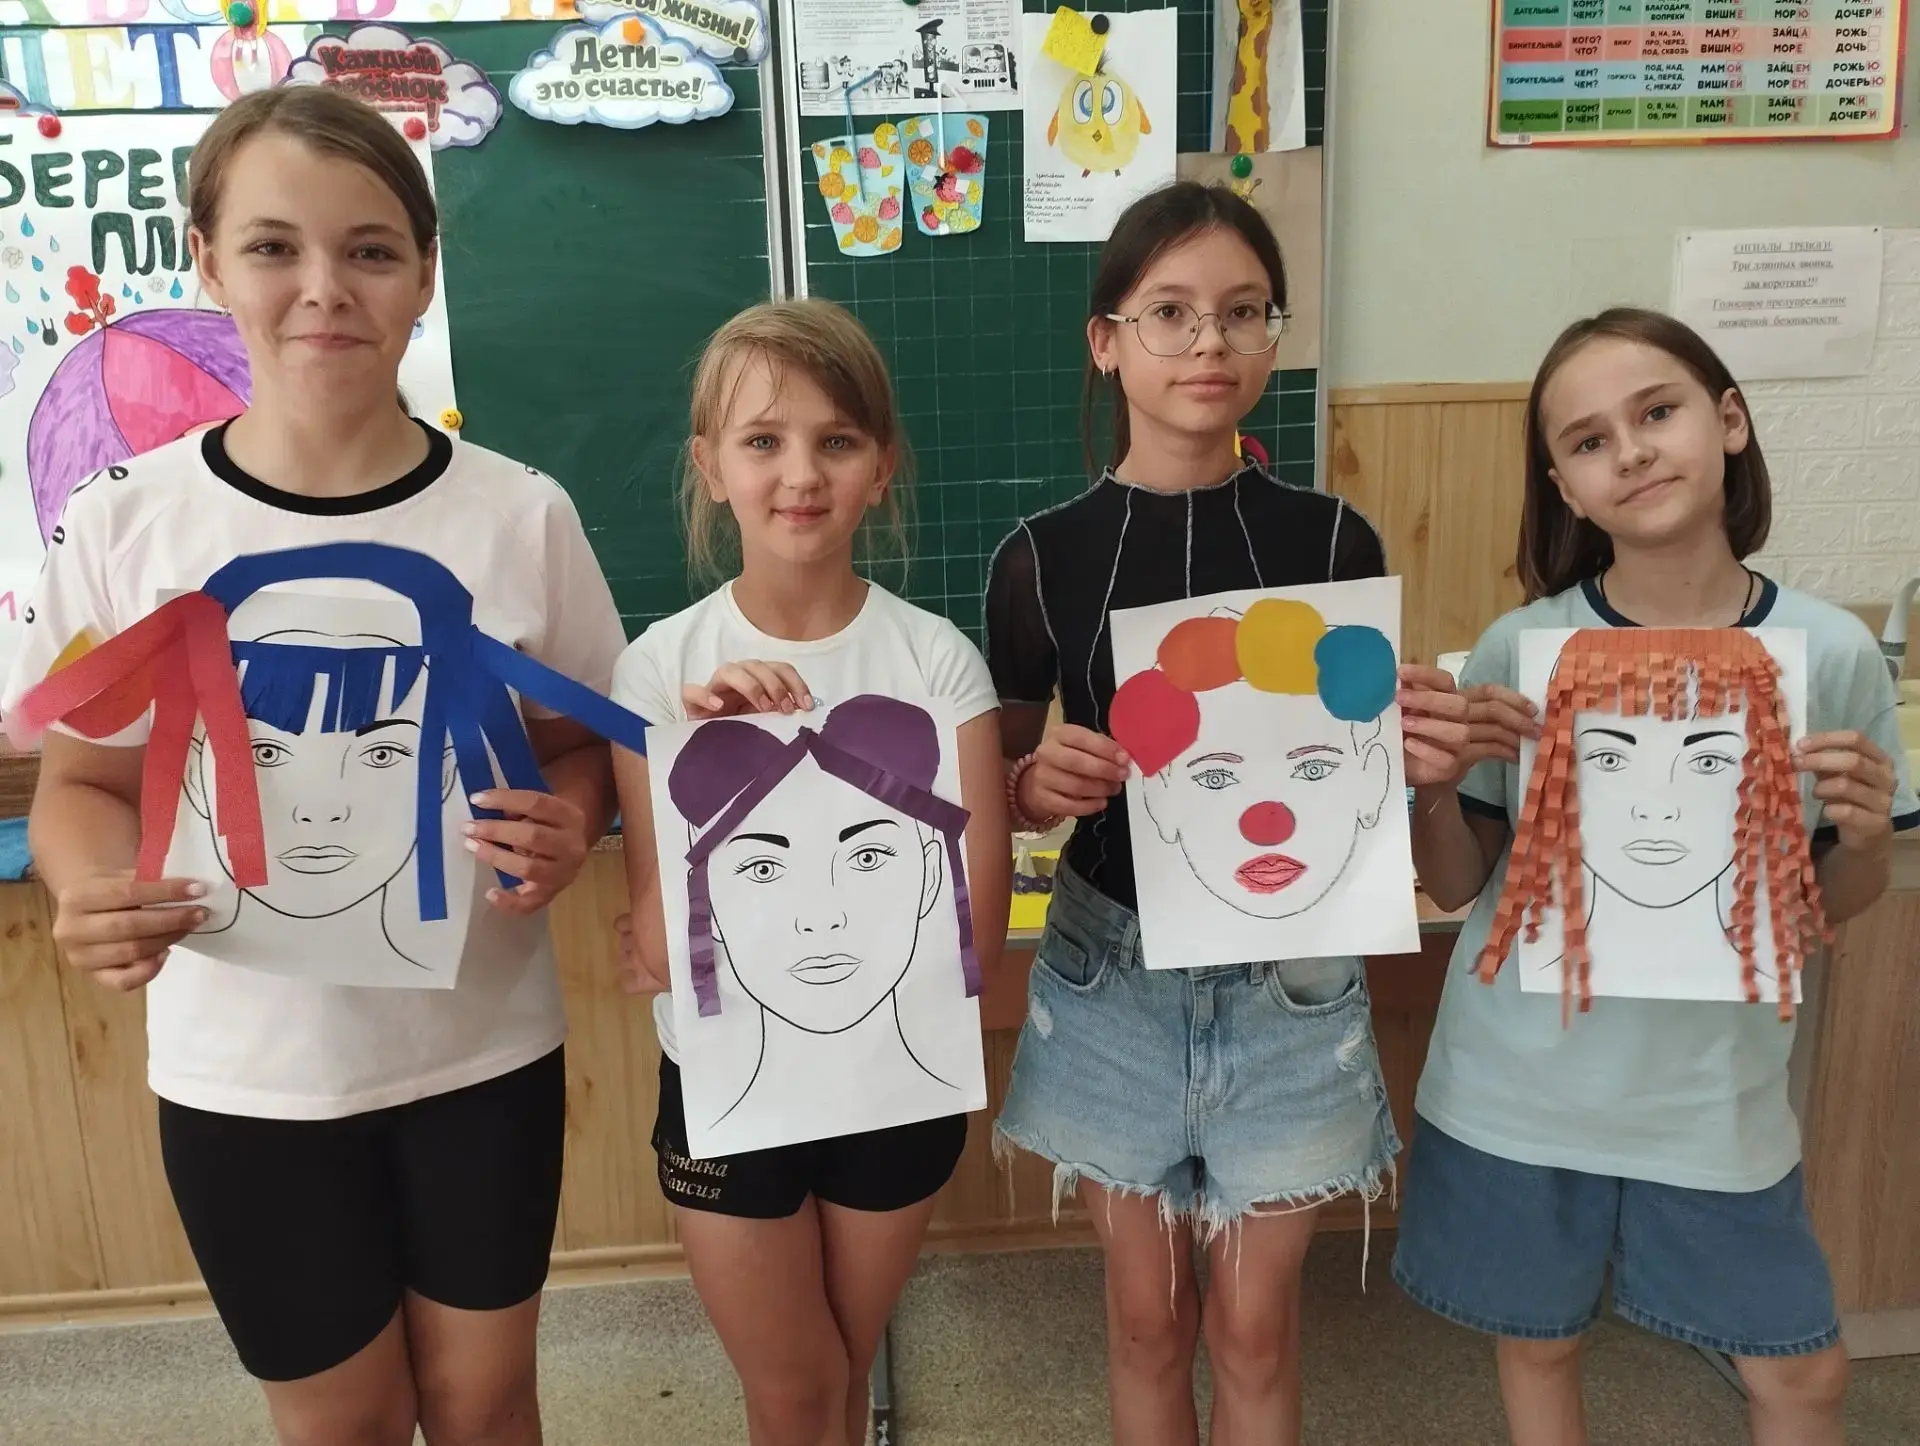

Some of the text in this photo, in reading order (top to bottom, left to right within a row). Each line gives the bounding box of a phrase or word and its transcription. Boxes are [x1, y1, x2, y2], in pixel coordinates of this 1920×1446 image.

[1514, 6, 1560, 15] ДАТЕЛЬНЫЙ
[661, 0, 755, 45] жизни!
[1835, 28, 1867, 37] РОЖЬ
[1572, 36, 1602, 45] КОГО?
[1508, 42, 1563, 51] ВИНИТЕЛЬНЫЙ
[1835, 42, 1867, 53] ДОЧЬ
[1574, 47, 1598, 56] ЧТО?
[319, 46, 442, 74] Каждый
[1575, 68, 1599, 78] КЕМ?
[1506, 76, 1565, 85] ТВОРИТЕЛЬНЫЙ
[1574, 80, 1599, 89] ЧЕМ?
[537, 78, 702, 101] это счастье!
[1654, 83, 1682, 91] МЕЖДУ
[1575, 103, 1600, 112] КОМ?
[1731, 260, 1751, 272] Три
